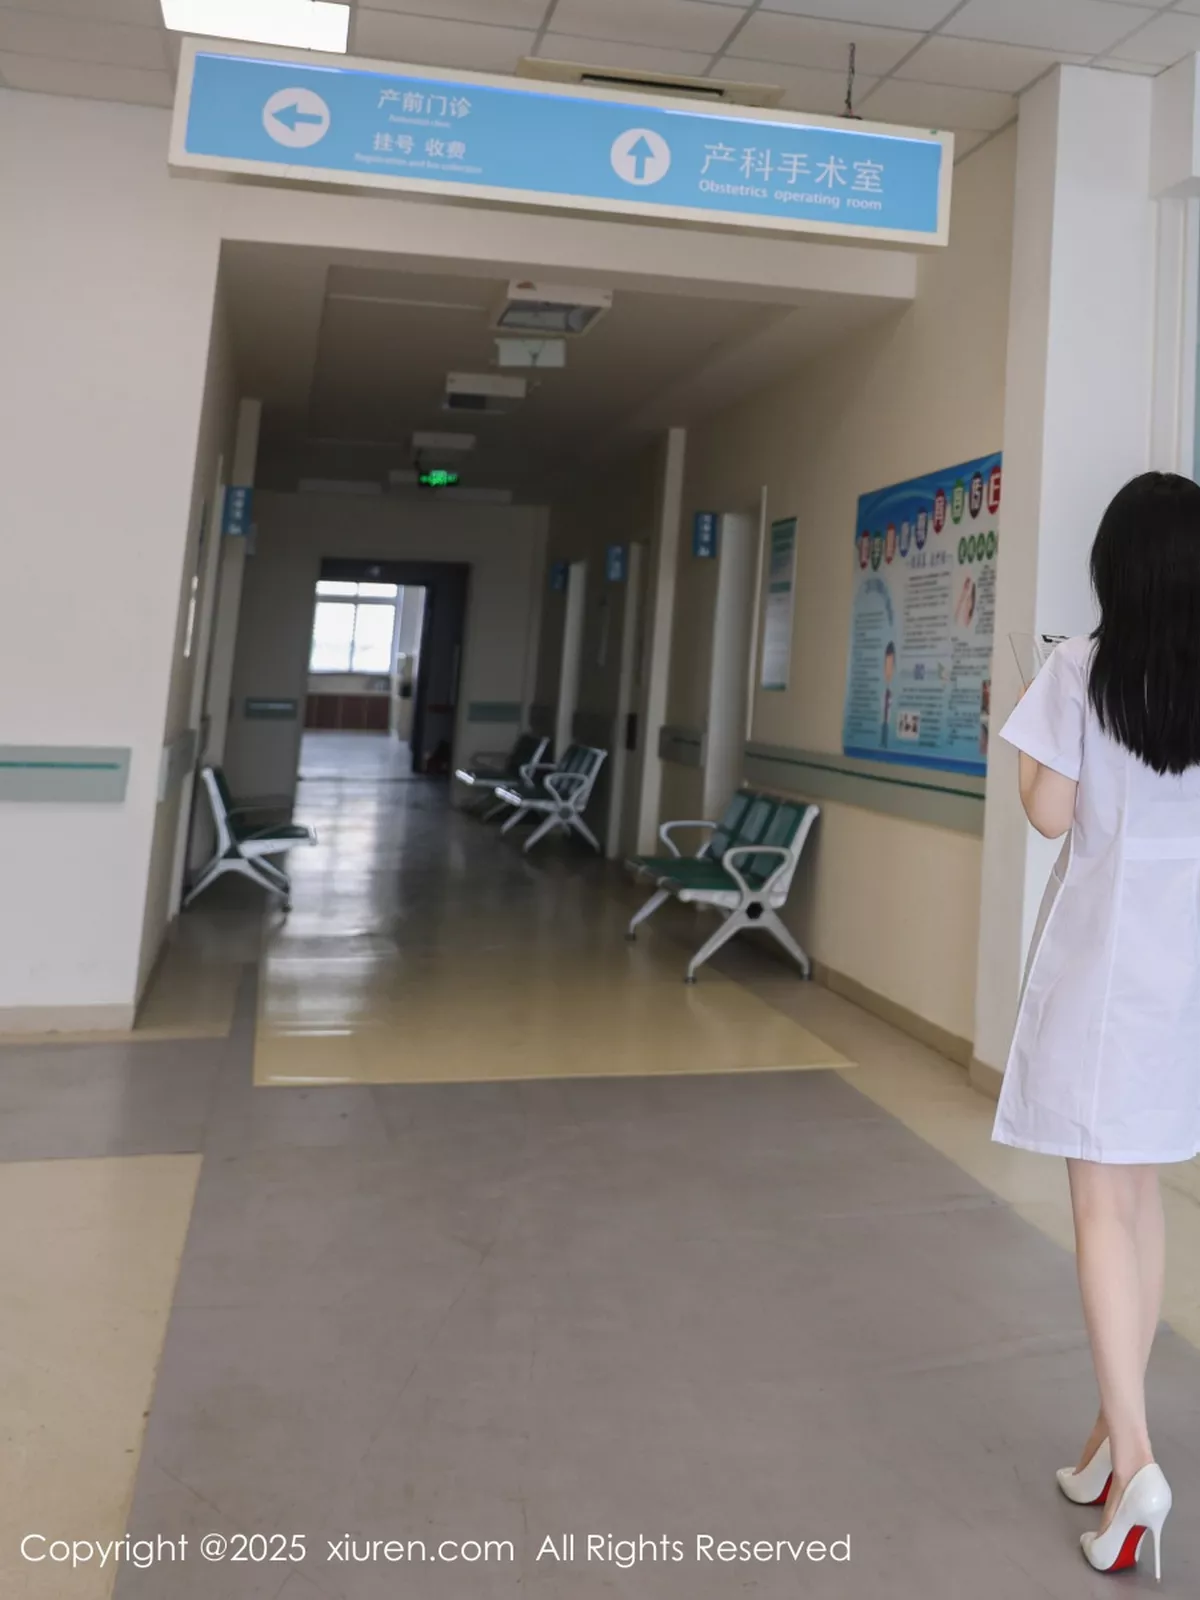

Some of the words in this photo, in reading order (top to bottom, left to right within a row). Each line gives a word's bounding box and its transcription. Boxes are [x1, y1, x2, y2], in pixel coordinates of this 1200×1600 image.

[377, 89, 472, 118] 产前门诊
[373, 132, 414, 155] 挂号
[425, 138, 466, 160] 收费
[700, 142, 884, 193] 产科手术室
[699, 179, 768, 199] Obstetrics
[774, 189, 841, 210] operating
[847, 197, 882, 211] room
